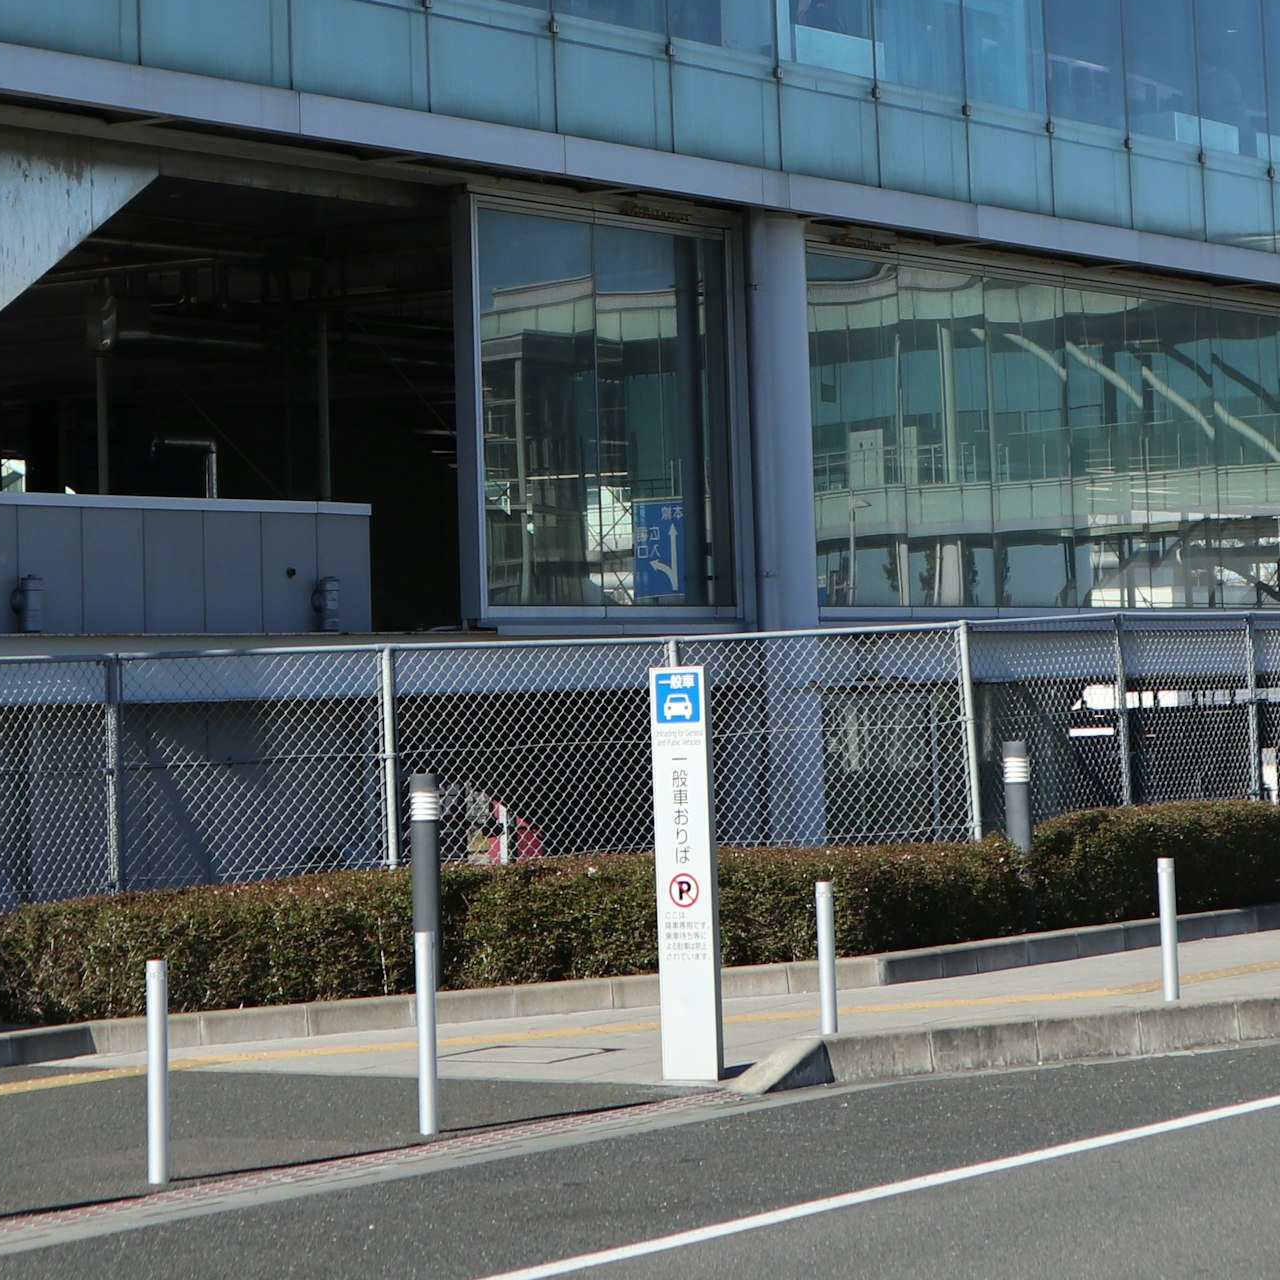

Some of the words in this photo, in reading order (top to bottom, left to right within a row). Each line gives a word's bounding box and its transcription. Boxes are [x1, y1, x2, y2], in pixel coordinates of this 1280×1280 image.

[658, 673, 696, 689] 一般車
[671, 756, 691, 865] 一般車おりば
